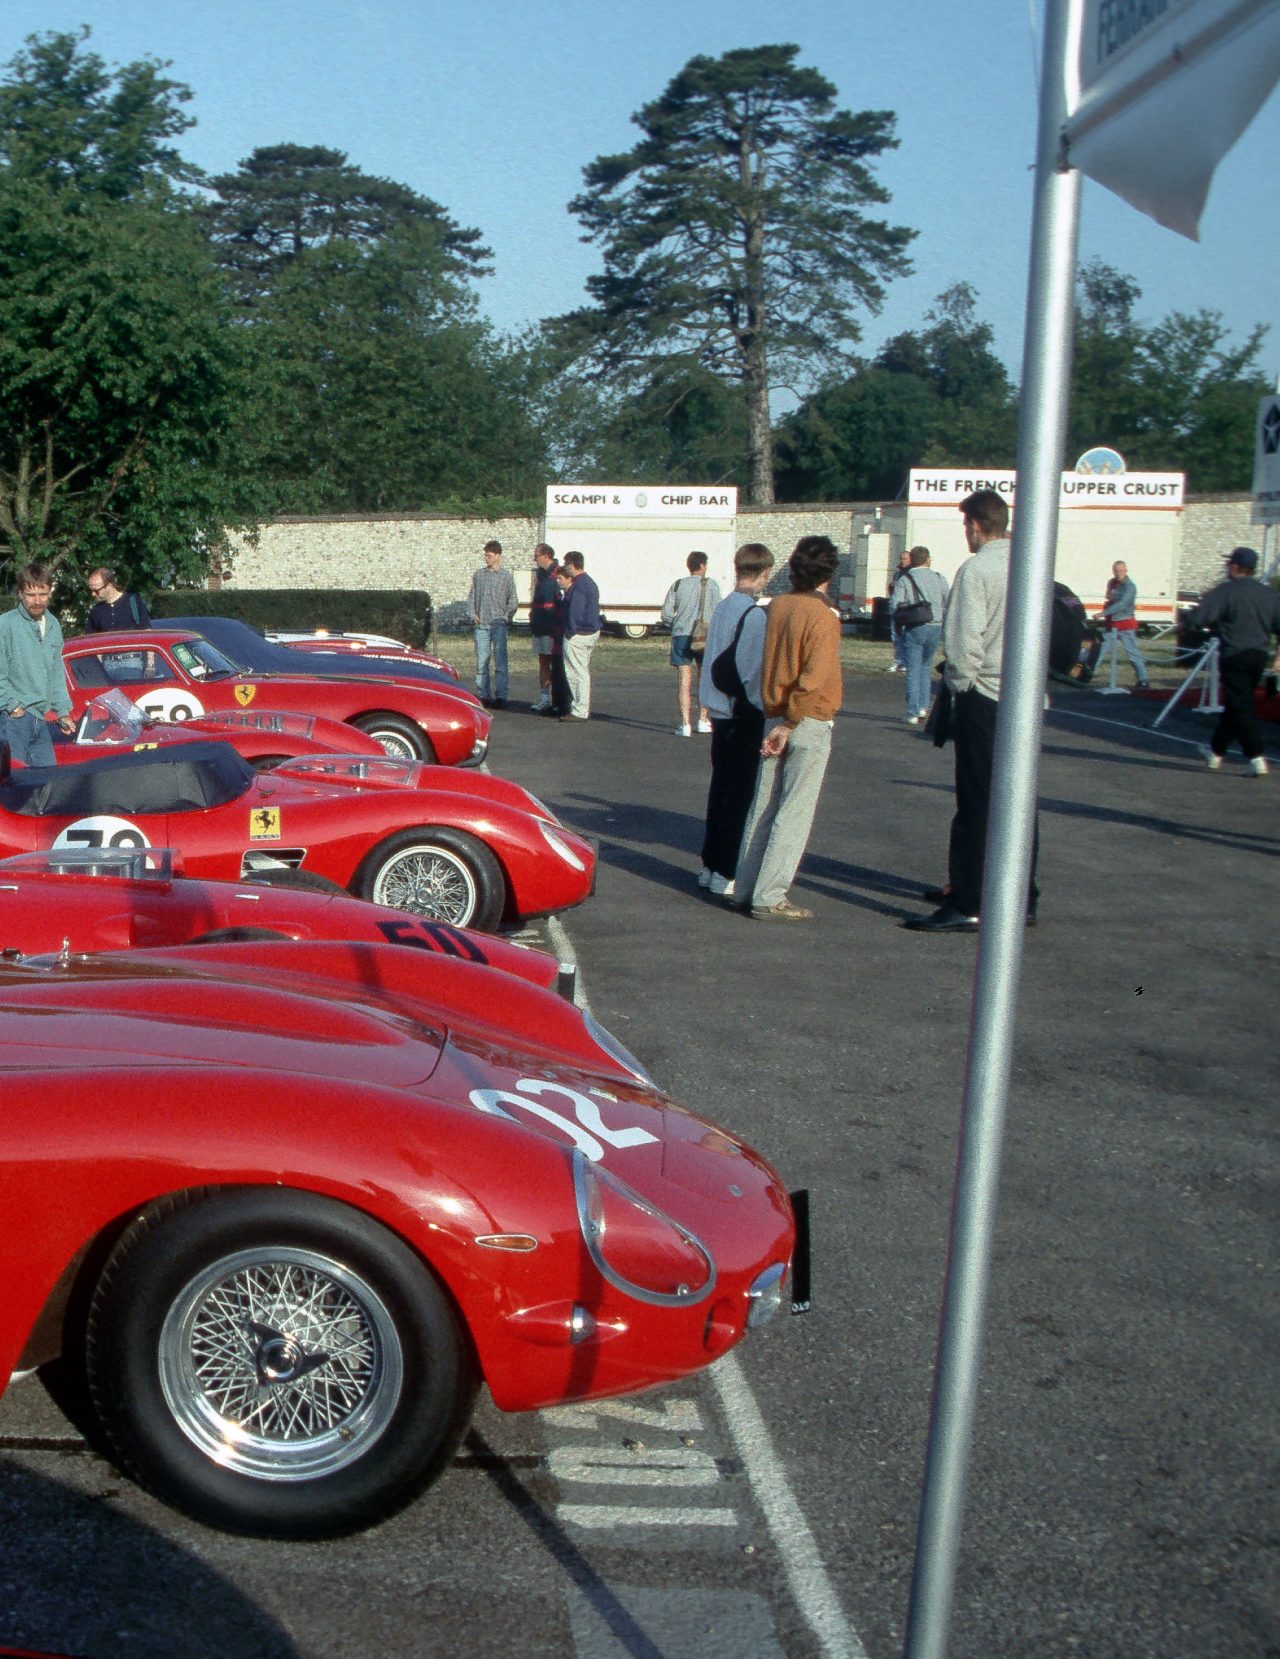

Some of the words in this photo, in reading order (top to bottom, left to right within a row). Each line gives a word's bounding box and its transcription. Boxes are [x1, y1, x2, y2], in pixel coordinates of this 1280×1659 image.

[914, 479, 951, 492] THE
[954, 480, 1017, 493] FRENCH
[1063, 482, 1117, 495] UPPER
[1123, 483, 1180, 496] CRUST
[554, 494, 606, 504] SCAMPI
[612, 495, 621, 505] &
[661, 495, 693, 505] CHIP
[699, 495, 729, 506] BAR
